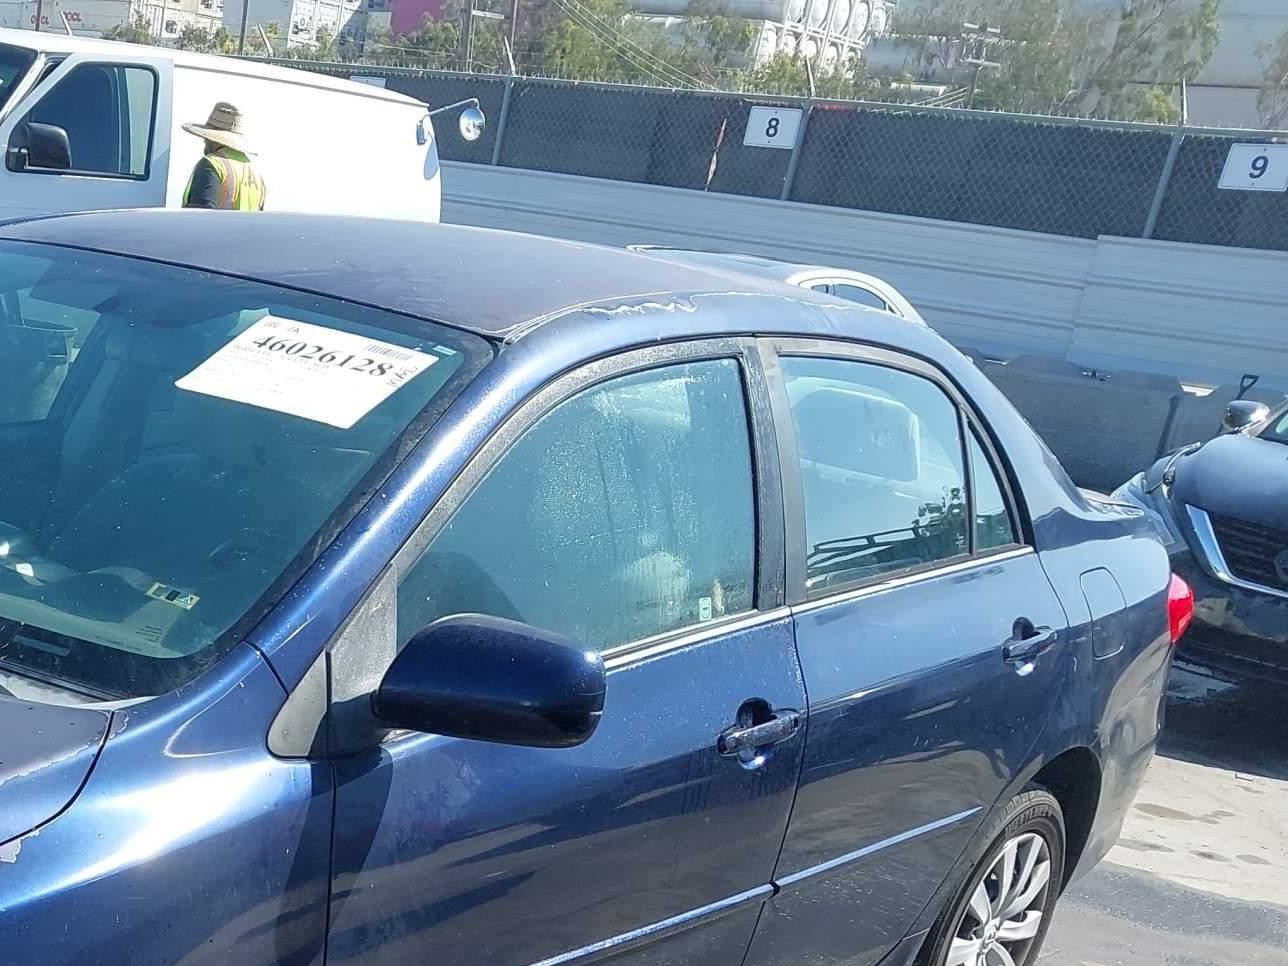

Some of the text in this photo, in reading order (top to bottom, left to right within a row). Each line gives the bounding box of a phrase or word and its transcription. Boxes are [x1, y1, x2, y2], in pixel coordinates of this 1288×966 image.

[30, 14, 50, 25] OCL
[766, 117, 780, 138] 8
[1249, 155, 1269, 179] 9
[252, 335, 394, 377] 46026128
